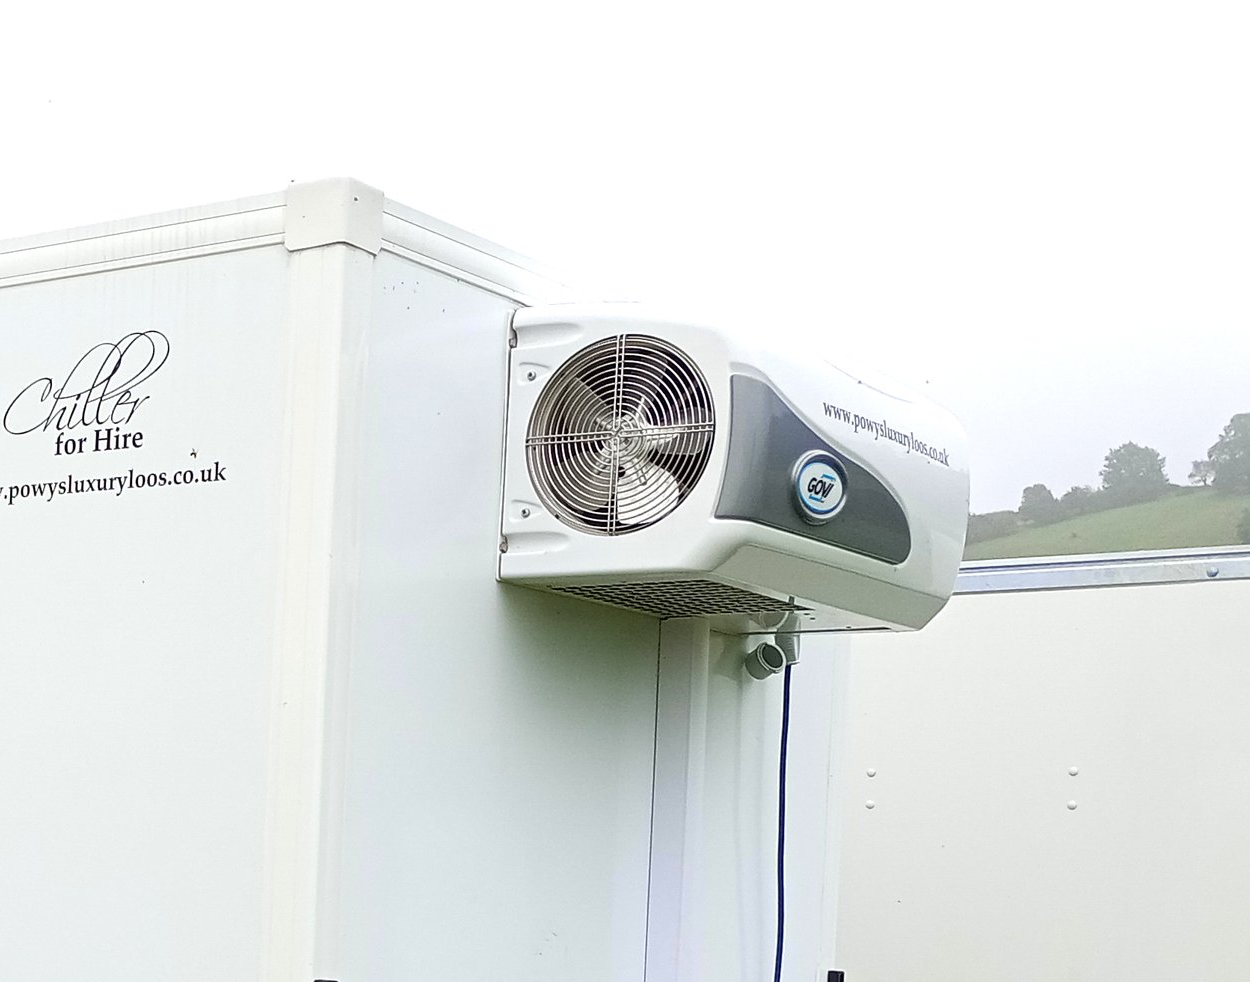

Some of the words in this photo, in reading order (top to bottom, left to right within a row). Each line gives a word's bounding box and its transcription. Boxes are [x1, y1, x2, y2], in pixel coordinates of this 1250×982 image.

[3, 330, 170, 435] Chiller
[54, 432, 87, 456] for
[93, 427, 144, 452] Hire
[823, 402, 950, 467] www.powysluxuryloos.co.uk
[807, 477, 834, 499] GOVI
